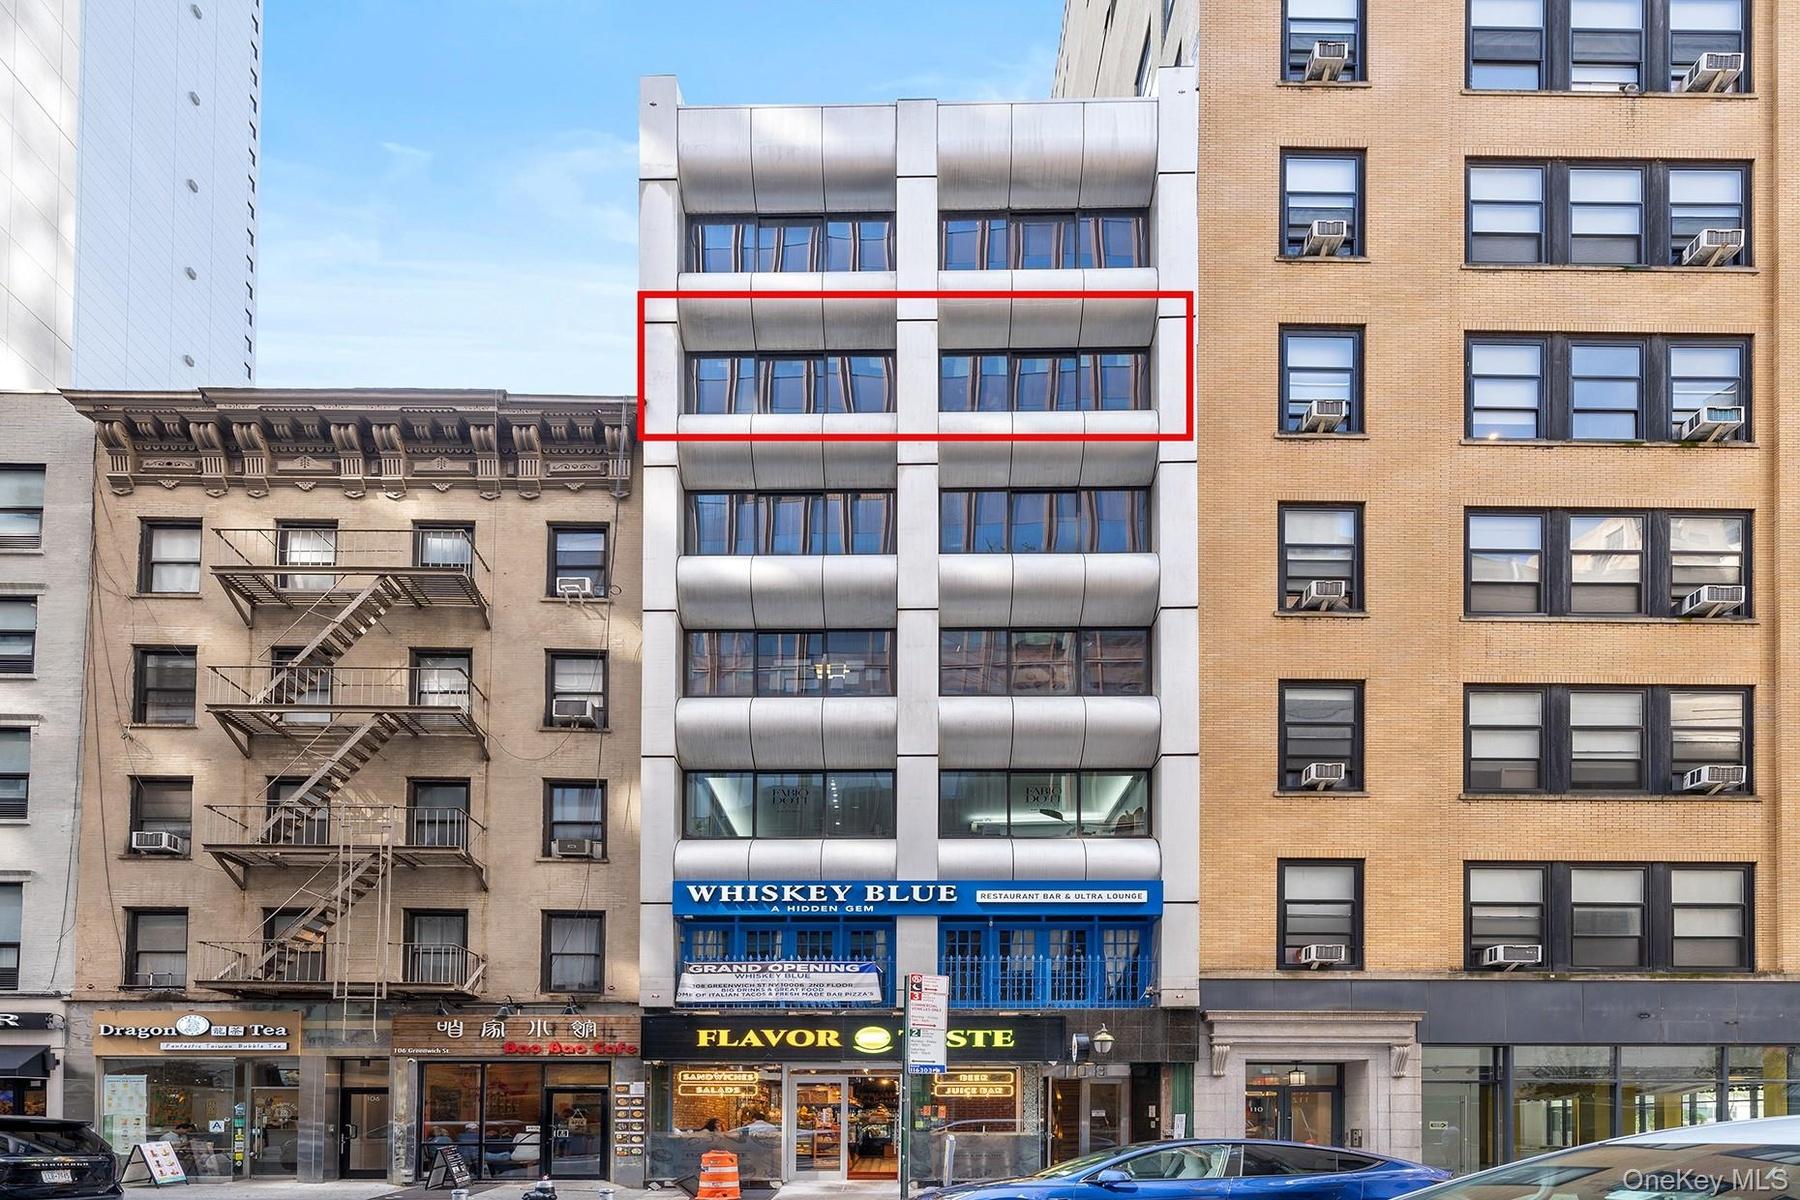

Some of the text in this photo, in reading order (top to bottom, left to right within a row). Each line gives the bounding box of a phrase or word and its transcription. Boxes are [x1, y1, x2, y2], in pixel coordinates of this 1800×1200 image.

[686, 885, 958, 903] WHISKEY BLUE
[688, 964, 860, 973] GRAND OPENING
[98, 1024, 177, 1039] Dragon
[249, 1024, 287, 1036] Tea
[696, 1029, 843, 1048] FLAVOR
[594, 1041, 638, 1054] Cafe
[682, 1073, 754, 1081] SANDWICHES
[696, 1086, 741, 1094] SALADS
[212, 1121, 222, 1129] A
